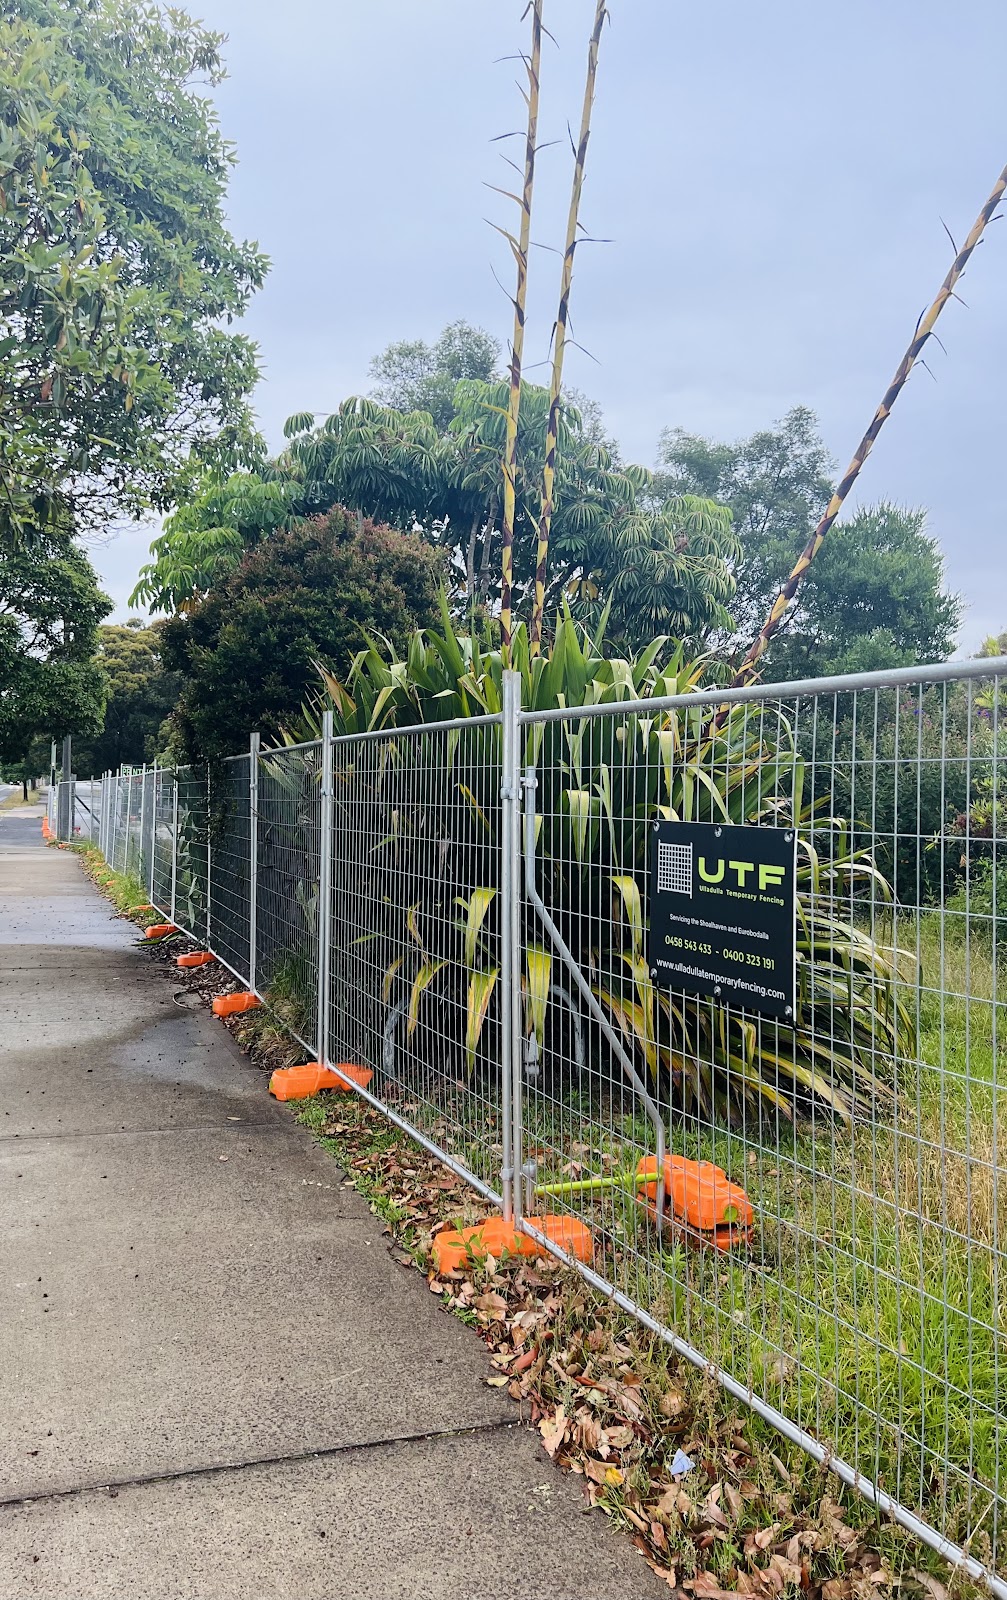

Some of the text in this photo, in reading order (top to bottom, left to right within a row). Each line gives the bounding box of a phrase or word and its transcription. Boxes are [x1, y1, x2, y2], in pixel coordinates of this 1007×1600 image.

[122, 768, 154, 776] PRNTG
[698, 856, 785, 891] UTF
[699, 885, 784, 906] Ulladulla Temporary Fencing
[669, 913, 690, 925] Servicing
[691, 917, 699, 926] the
[727, 926, 737, 934] and
[738, 926, 769, 940] Eurobodalla
[665, 935, 683, 948] 0458
[684, 939, 697, 951] 543
[698, 943, 712, 955] 433
[723, 948, 744, 963] 0400
[745, 953, 761, 967] 323
[762, 957, 775, 970] 191
[656, 958, 785, 1001] www.ulladullatemporaryfencing.com
